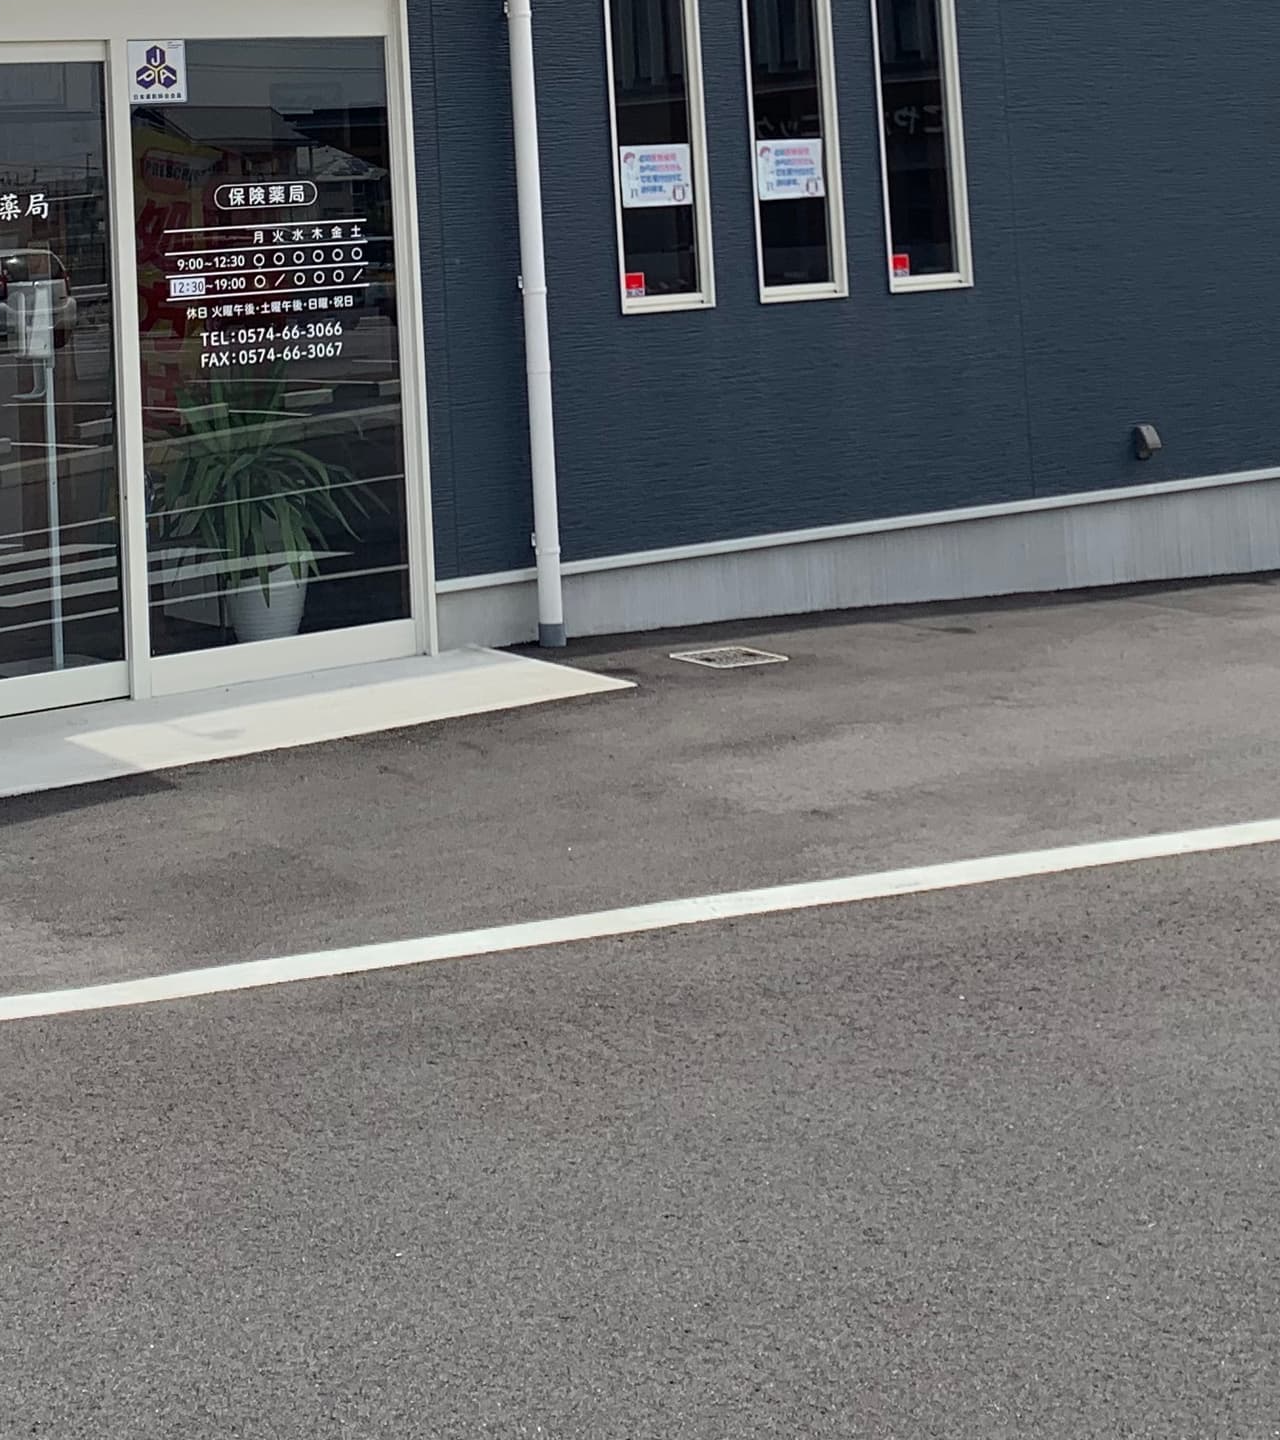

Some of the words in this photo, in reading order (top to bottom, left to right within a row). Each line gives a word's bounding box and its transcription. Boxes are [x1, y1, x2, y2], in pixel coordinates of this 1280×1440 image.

[228, 184, 305, 207] 保険薬局
[186, 306, 208, 320] 休日
